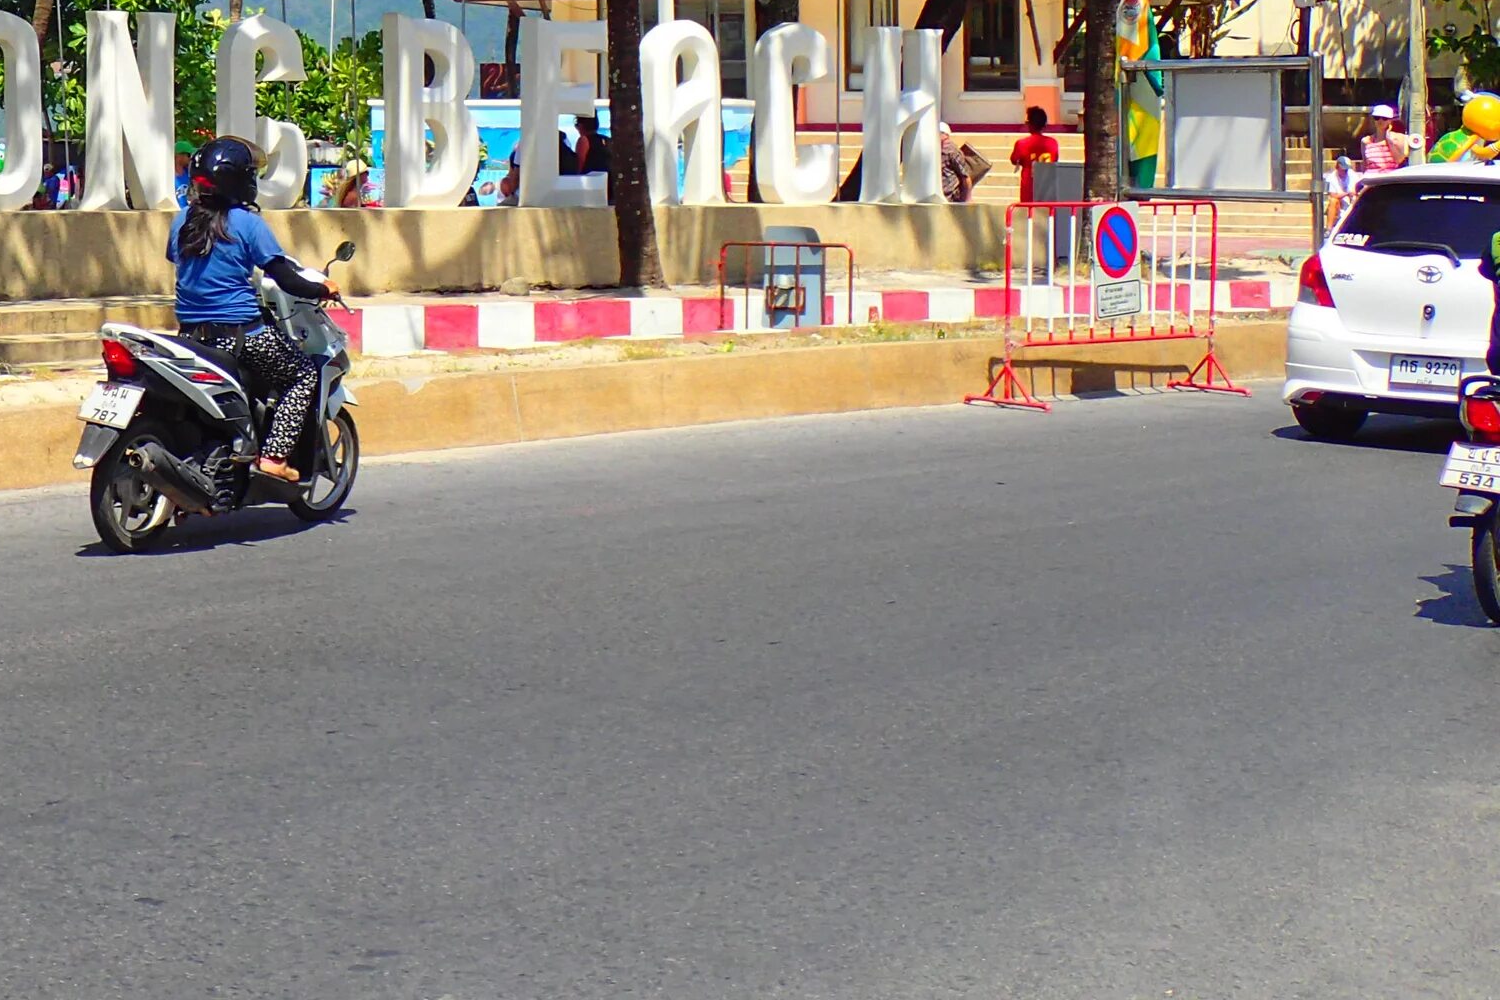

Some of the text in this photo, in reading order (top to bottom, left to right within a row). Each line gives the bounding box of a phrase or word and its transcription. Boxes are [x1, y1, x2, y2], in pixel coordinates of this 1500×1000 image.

[384, 14, 945, 207] BEACH
[1425, 361, 1457, 376] 9270
[91, 408, 117, 422] 787
[1459, 472, 1494, 488] 534
